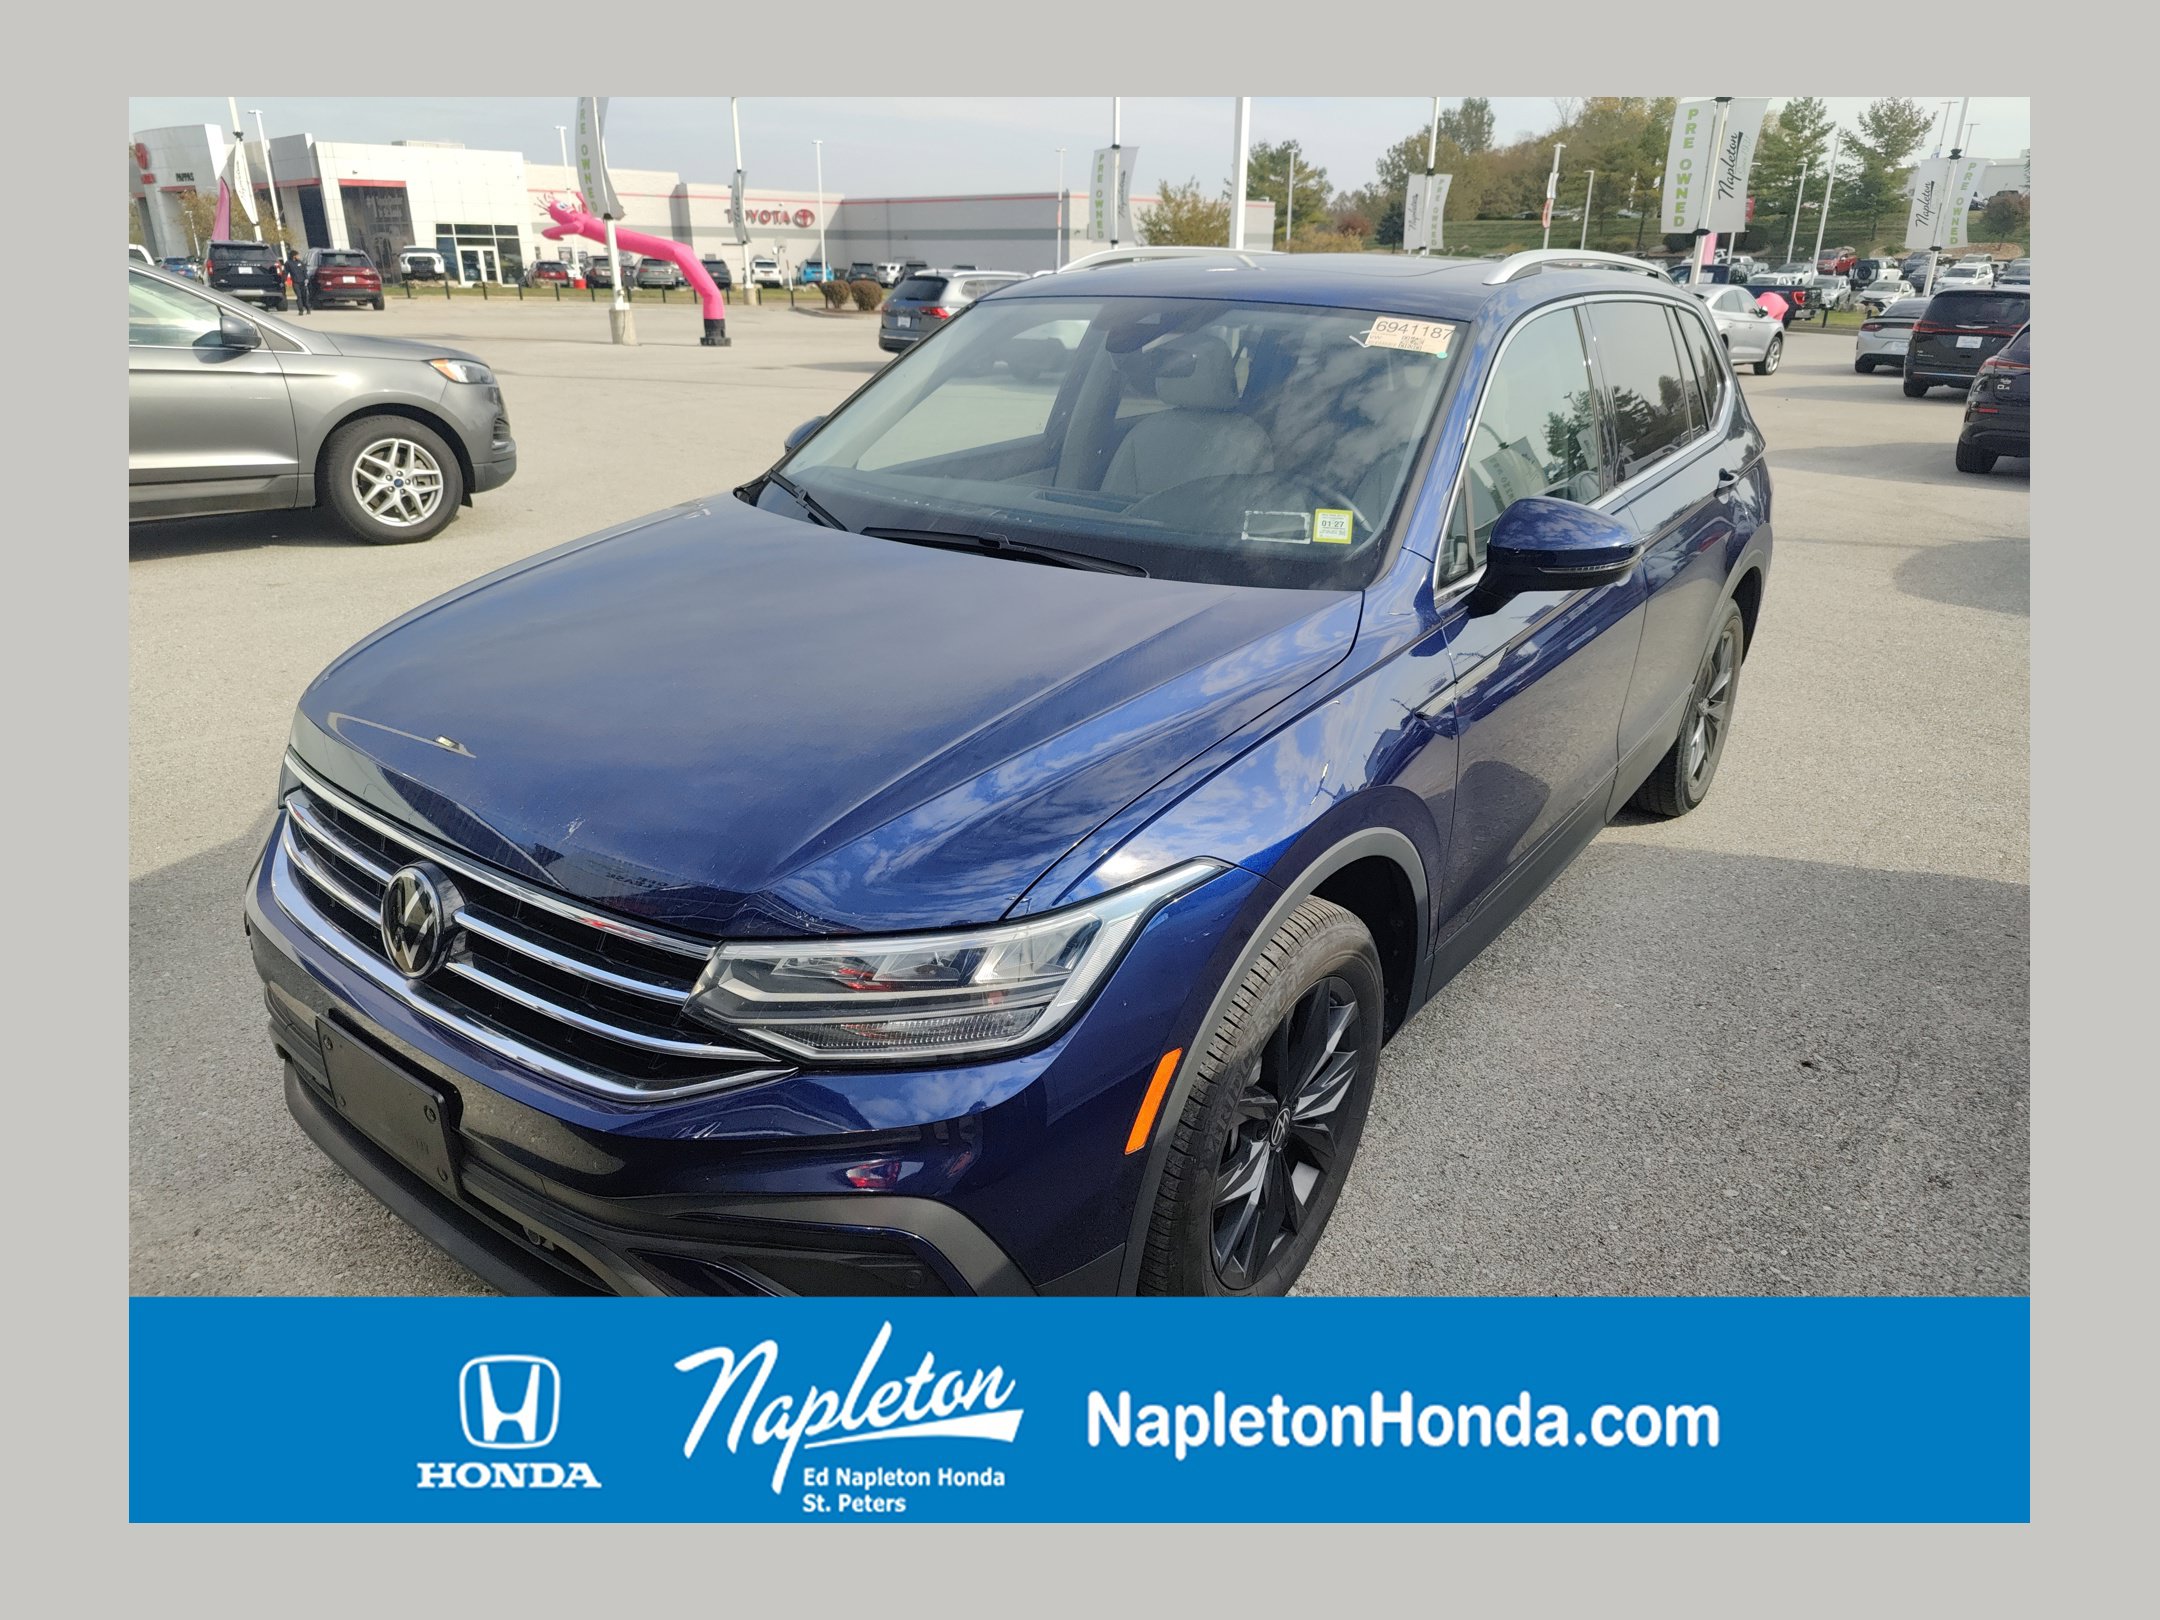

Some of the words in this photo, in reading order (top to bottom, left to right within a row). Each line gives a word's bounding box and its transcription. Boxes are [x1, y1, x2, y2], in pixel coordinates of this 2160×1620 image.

[1683, 108, 1699, 149] PRE
[581, 144, 599, 213] OWNED
[1717, 131, 1743, 201] Napleton
[1961, 162, 1977, 191] PRE
[724, 208, 791, 225] TYOTA
[1095, 190, 1104, 239] OWNED
[1674, 158, 1693, 227] OWNED
[1915, 180, 1935, 228] Napleton
[1950, 197, 1963, 245] OWNED
[1376, 320, 1455, 341] 6941187
